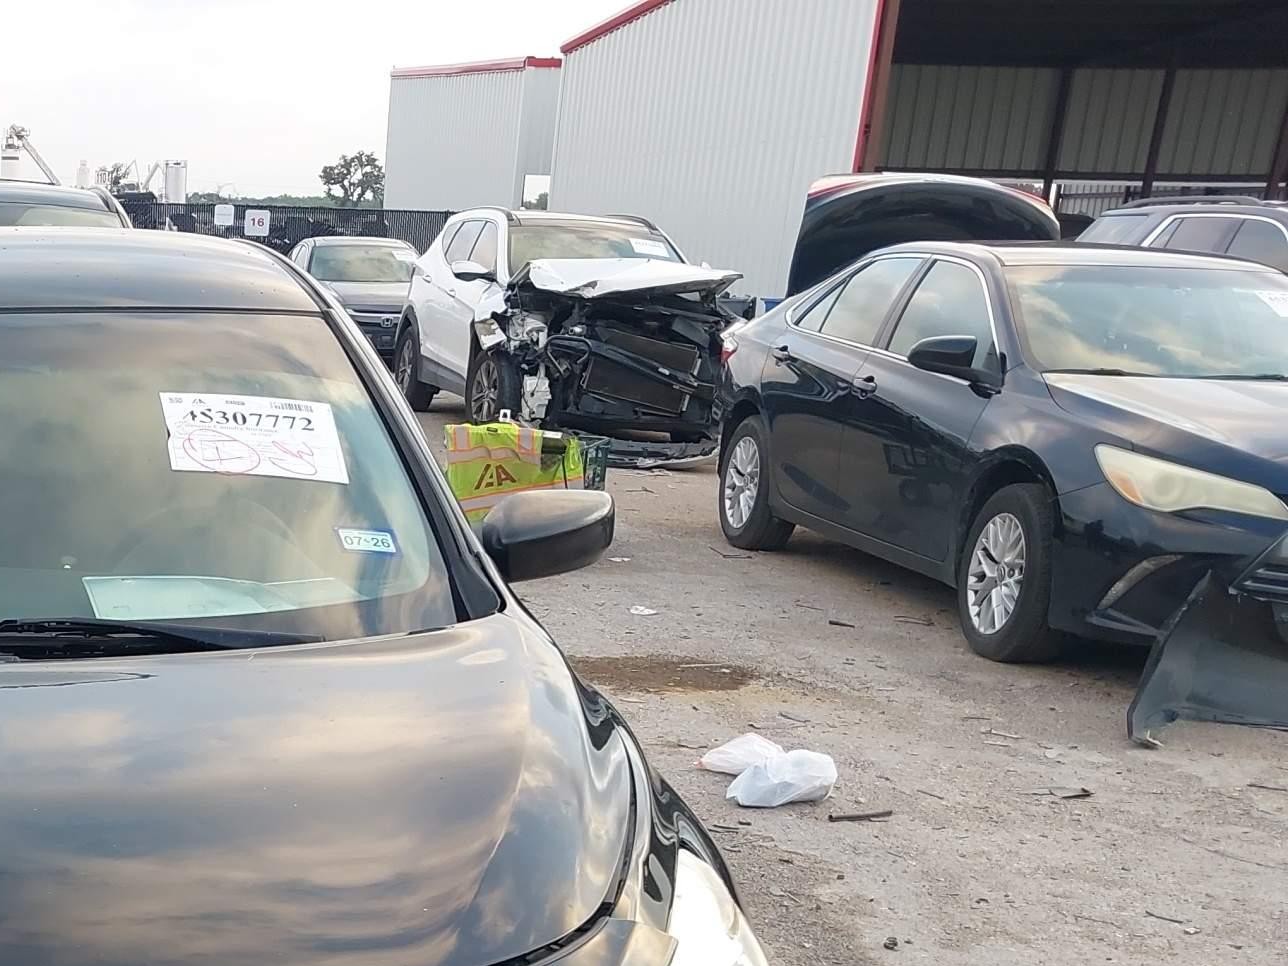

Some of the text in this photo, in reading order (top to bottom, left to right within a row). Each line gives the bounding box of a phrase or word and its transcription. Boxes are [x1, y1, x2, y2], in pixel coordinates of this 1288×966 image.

[250, 217, 265, 227] 16
[343, 535, 391, 548] 07 26
